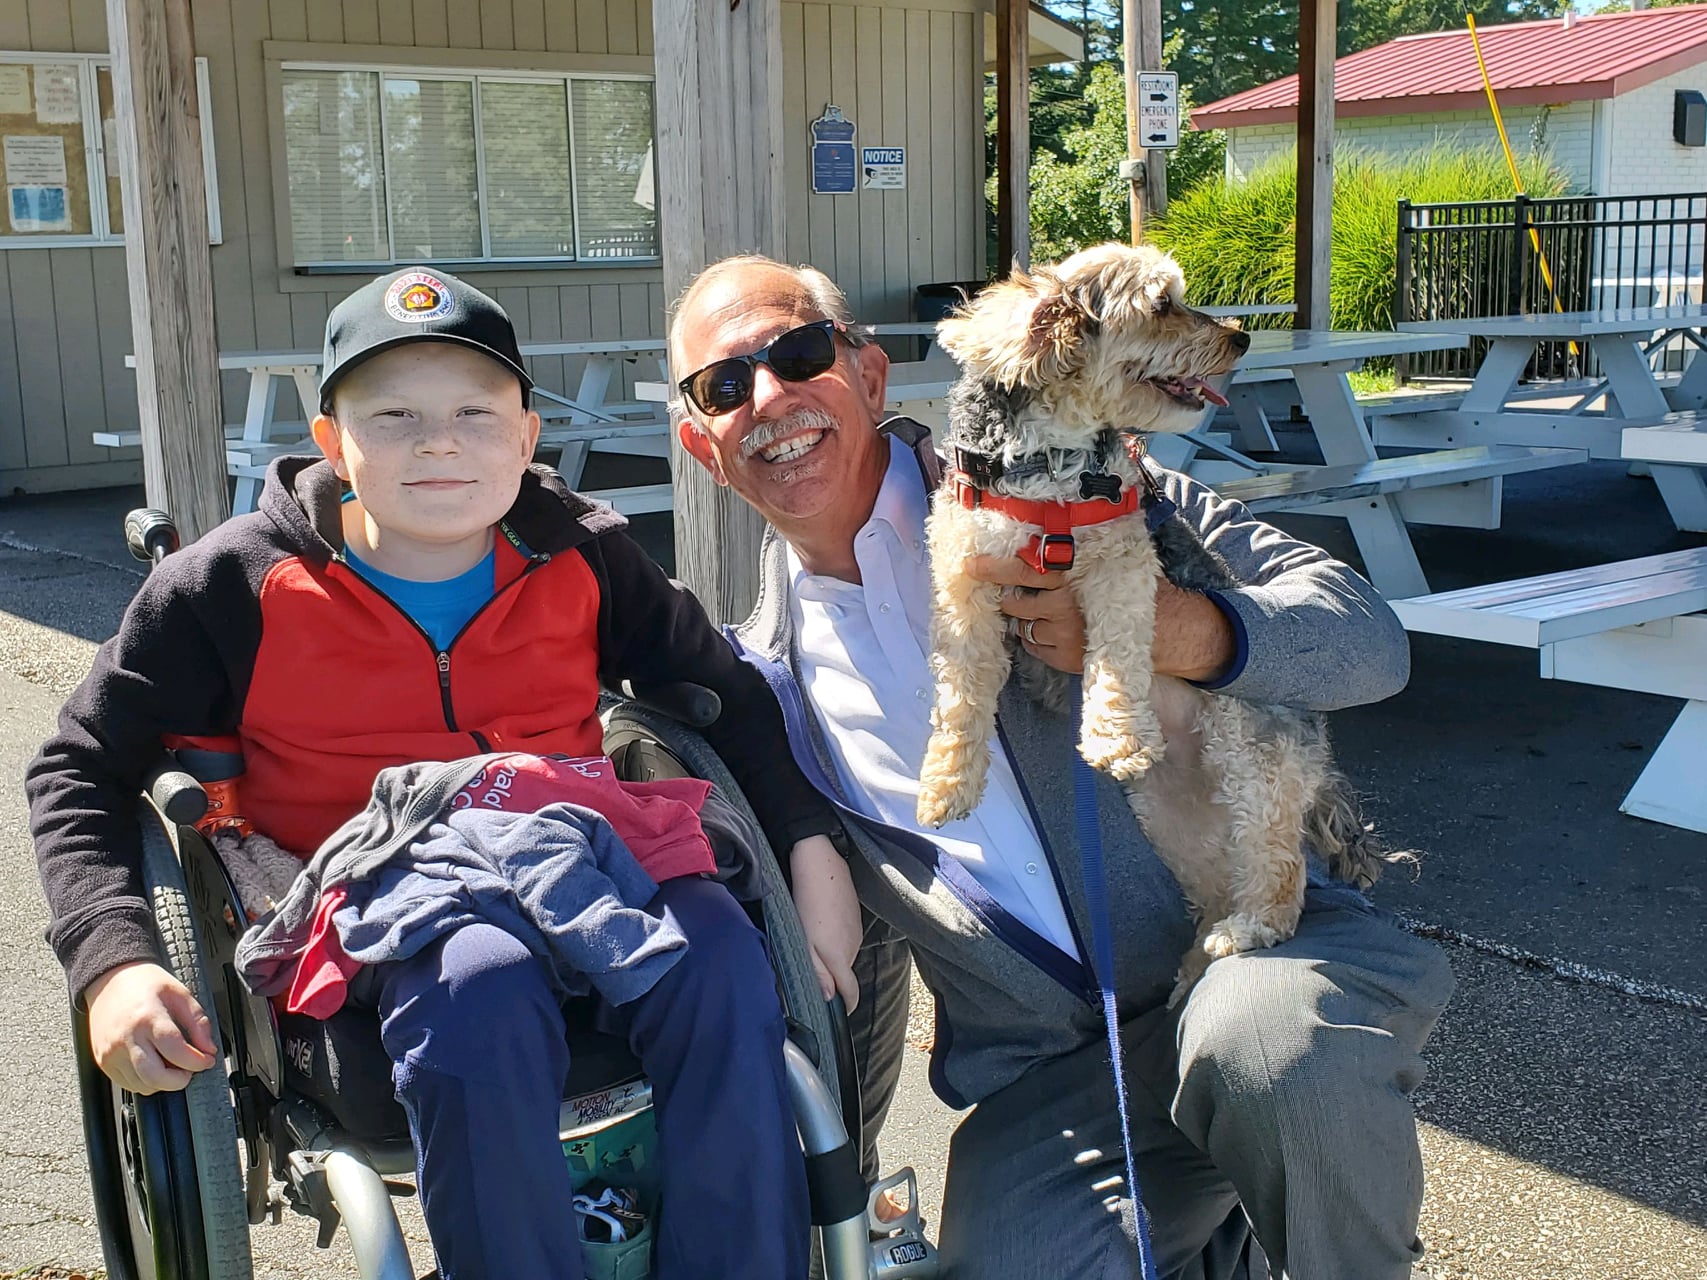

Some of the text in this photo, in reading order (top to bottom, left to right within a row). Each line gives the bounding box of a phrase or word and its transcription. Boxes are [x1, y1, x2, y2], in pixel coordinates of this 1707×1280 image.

[1141, 105, 1175, 116] EMERGENCY
[1149, 119, 1168, 130] PHONE
[864, 150, 902, 162] NOTICE
[572, 1092, 611, 1112] MOTION
[577, 1098, 618, 1120] MOBILITY
[892, 1243, 926, 1264] ROGUE
